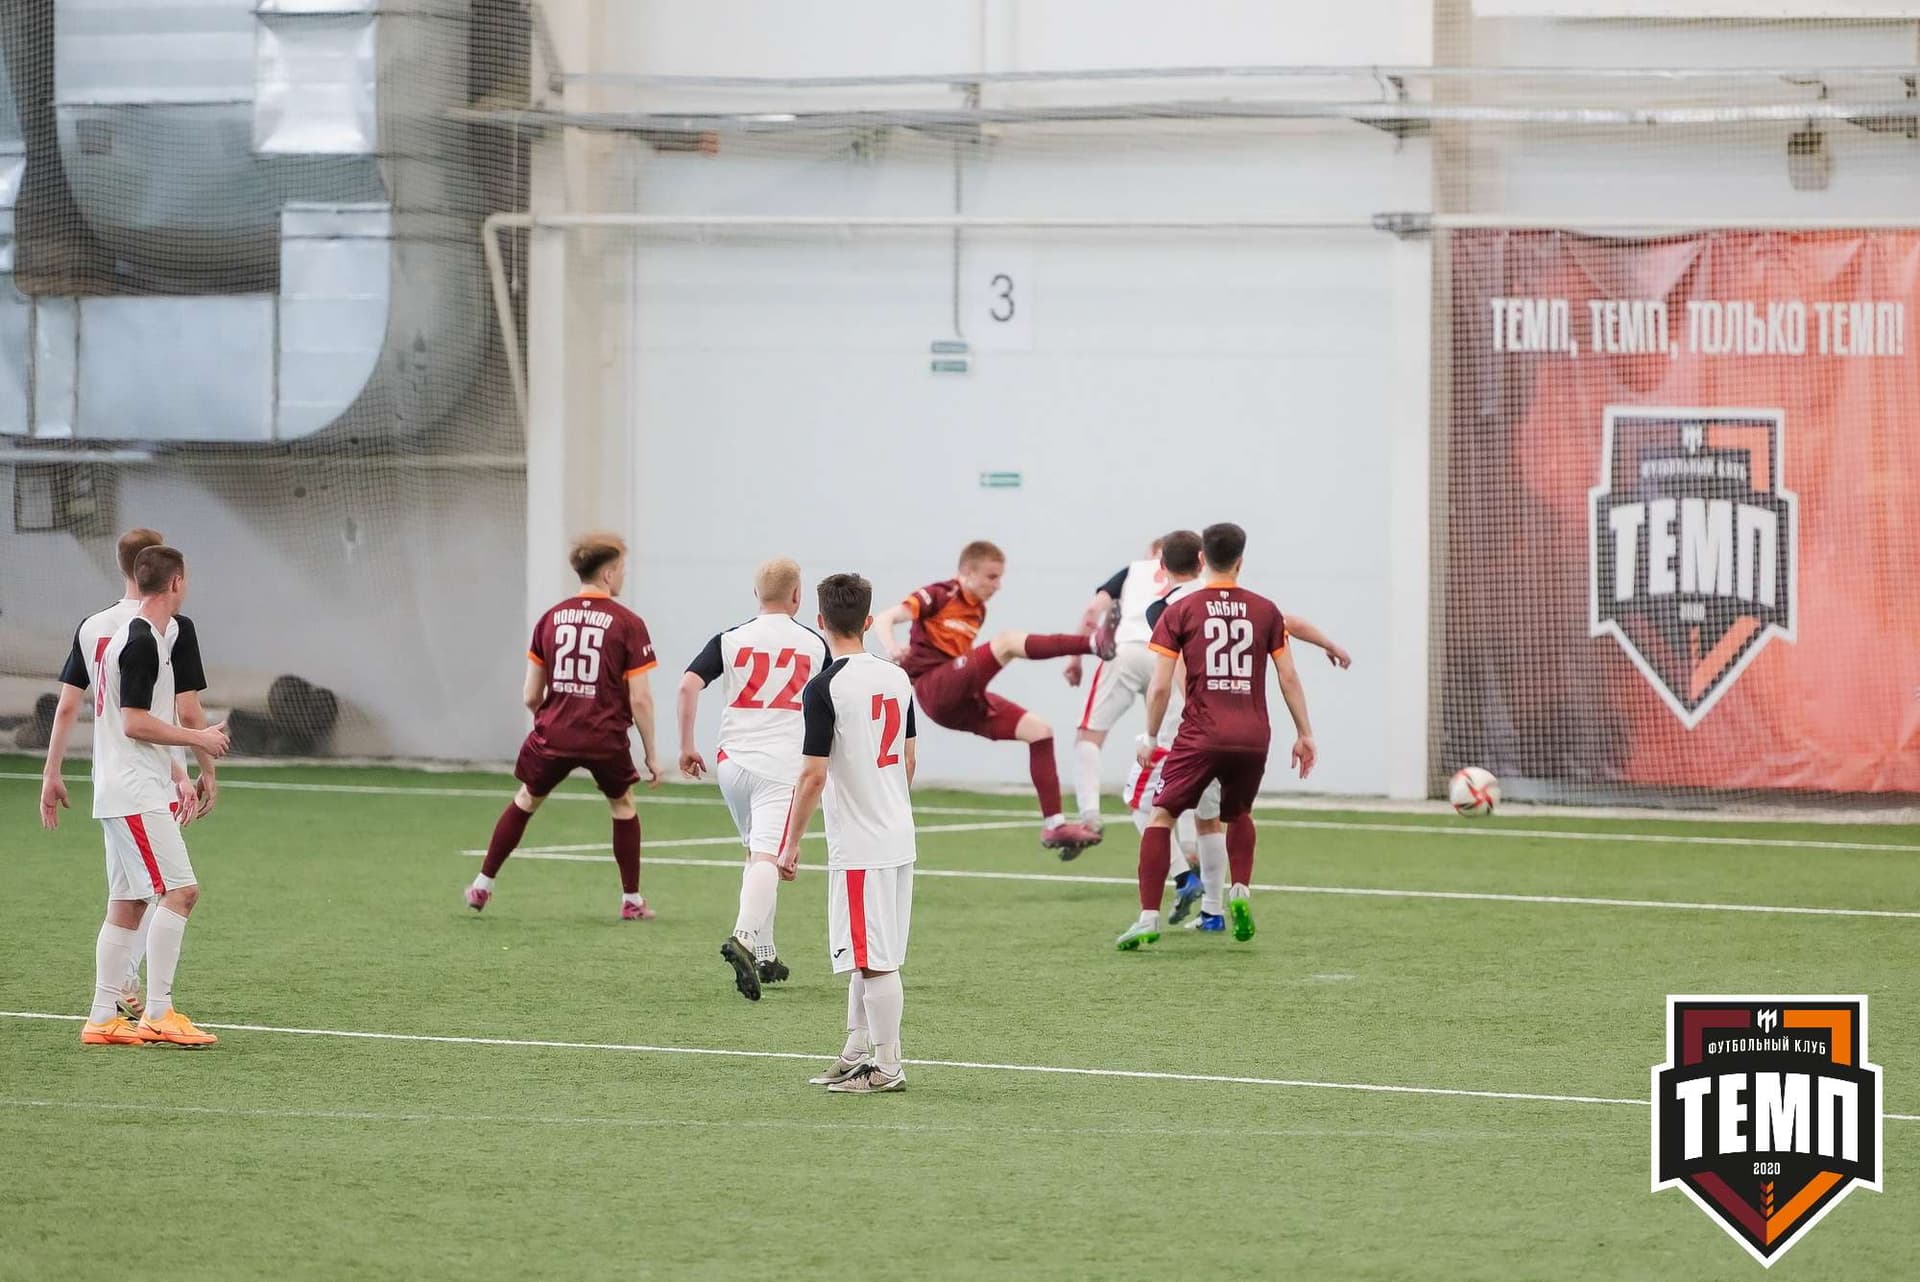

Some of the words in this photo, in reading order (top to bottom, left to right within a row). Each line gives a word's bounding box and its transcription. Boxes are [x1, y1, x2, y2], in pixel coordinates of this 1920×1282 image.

[990, 274, 1015, 322] 3
[1490, 298, 1578, 358] ТЕМП,
[1589, 299, 1678, 360] ТЕМП,
[1688, 301, 1806, 355] ТОЛЬКО
[1814, 302, 1904, 356] ТЕМП!
[1609, 498, 1776, 608] ТЕМП
[1206, 601, 1247, 618] БАБИЧ
[553, 625, 605, 683] 25
[1204, 618, 1254, 678] 22
[729, 647, 812, 712] 22
[871, 693, 902, 769] 2
